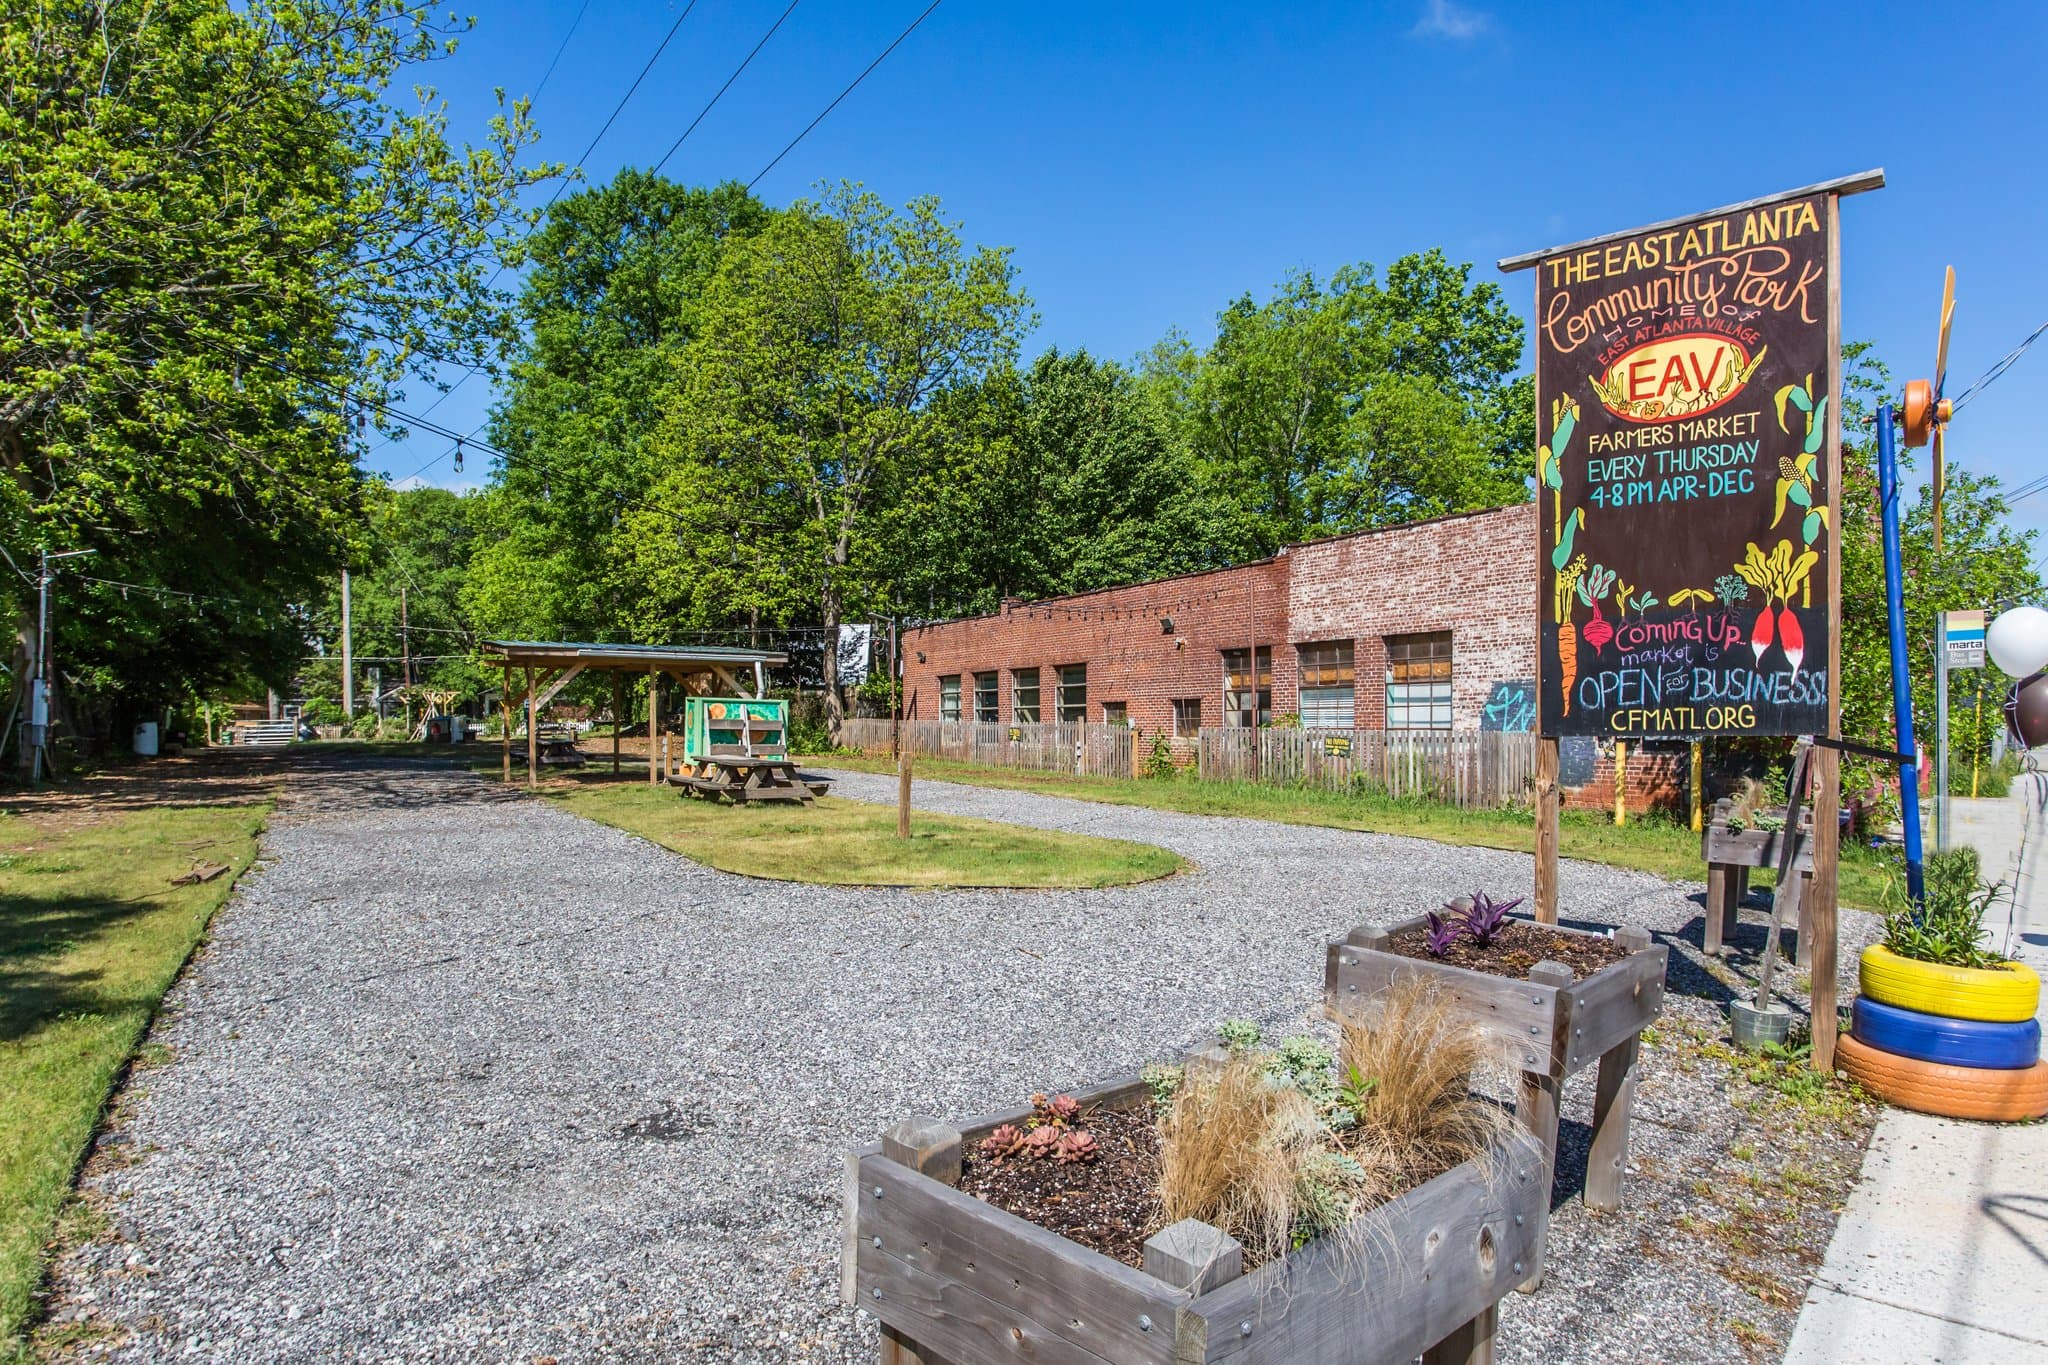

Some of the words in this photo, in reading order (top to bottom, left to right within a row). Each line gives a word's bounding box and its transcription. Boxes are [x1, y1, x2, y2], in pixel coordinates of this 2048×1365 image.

[1546, 249, 1601, 288] THE
[1604, 231, 1680, 278] EAST
[1678, 201, 1820, 262] ATLANTA
[1541, 262, 1728, 353] Community
[1732, 246, 1824, 324] Park
[1597, 334, 1631, 366] EAST
[1634, 316, 1703, 342] ATLANTA
[1706, 317, 1761, 345] VILLAGE
[1602, 304, 1697, 342] HOME
[1629, 346, 1726, 402] EAV
[1588, 424, 1674, 454] FARMERS
[1679, 411, 1761, 442] MARKET
[1588, 453, 1647, 483] EVERY
[1653, 440, 1760, 475] THURSDAY
[1621, 643, 1695, 667] market
[1704, 642, 1719, 662] is
[1949, 641, 1983, 649] marta
[1578, 664, 1663, 710] OPEN
[1611, 703, 1757, 731] CFMATL.ORG
